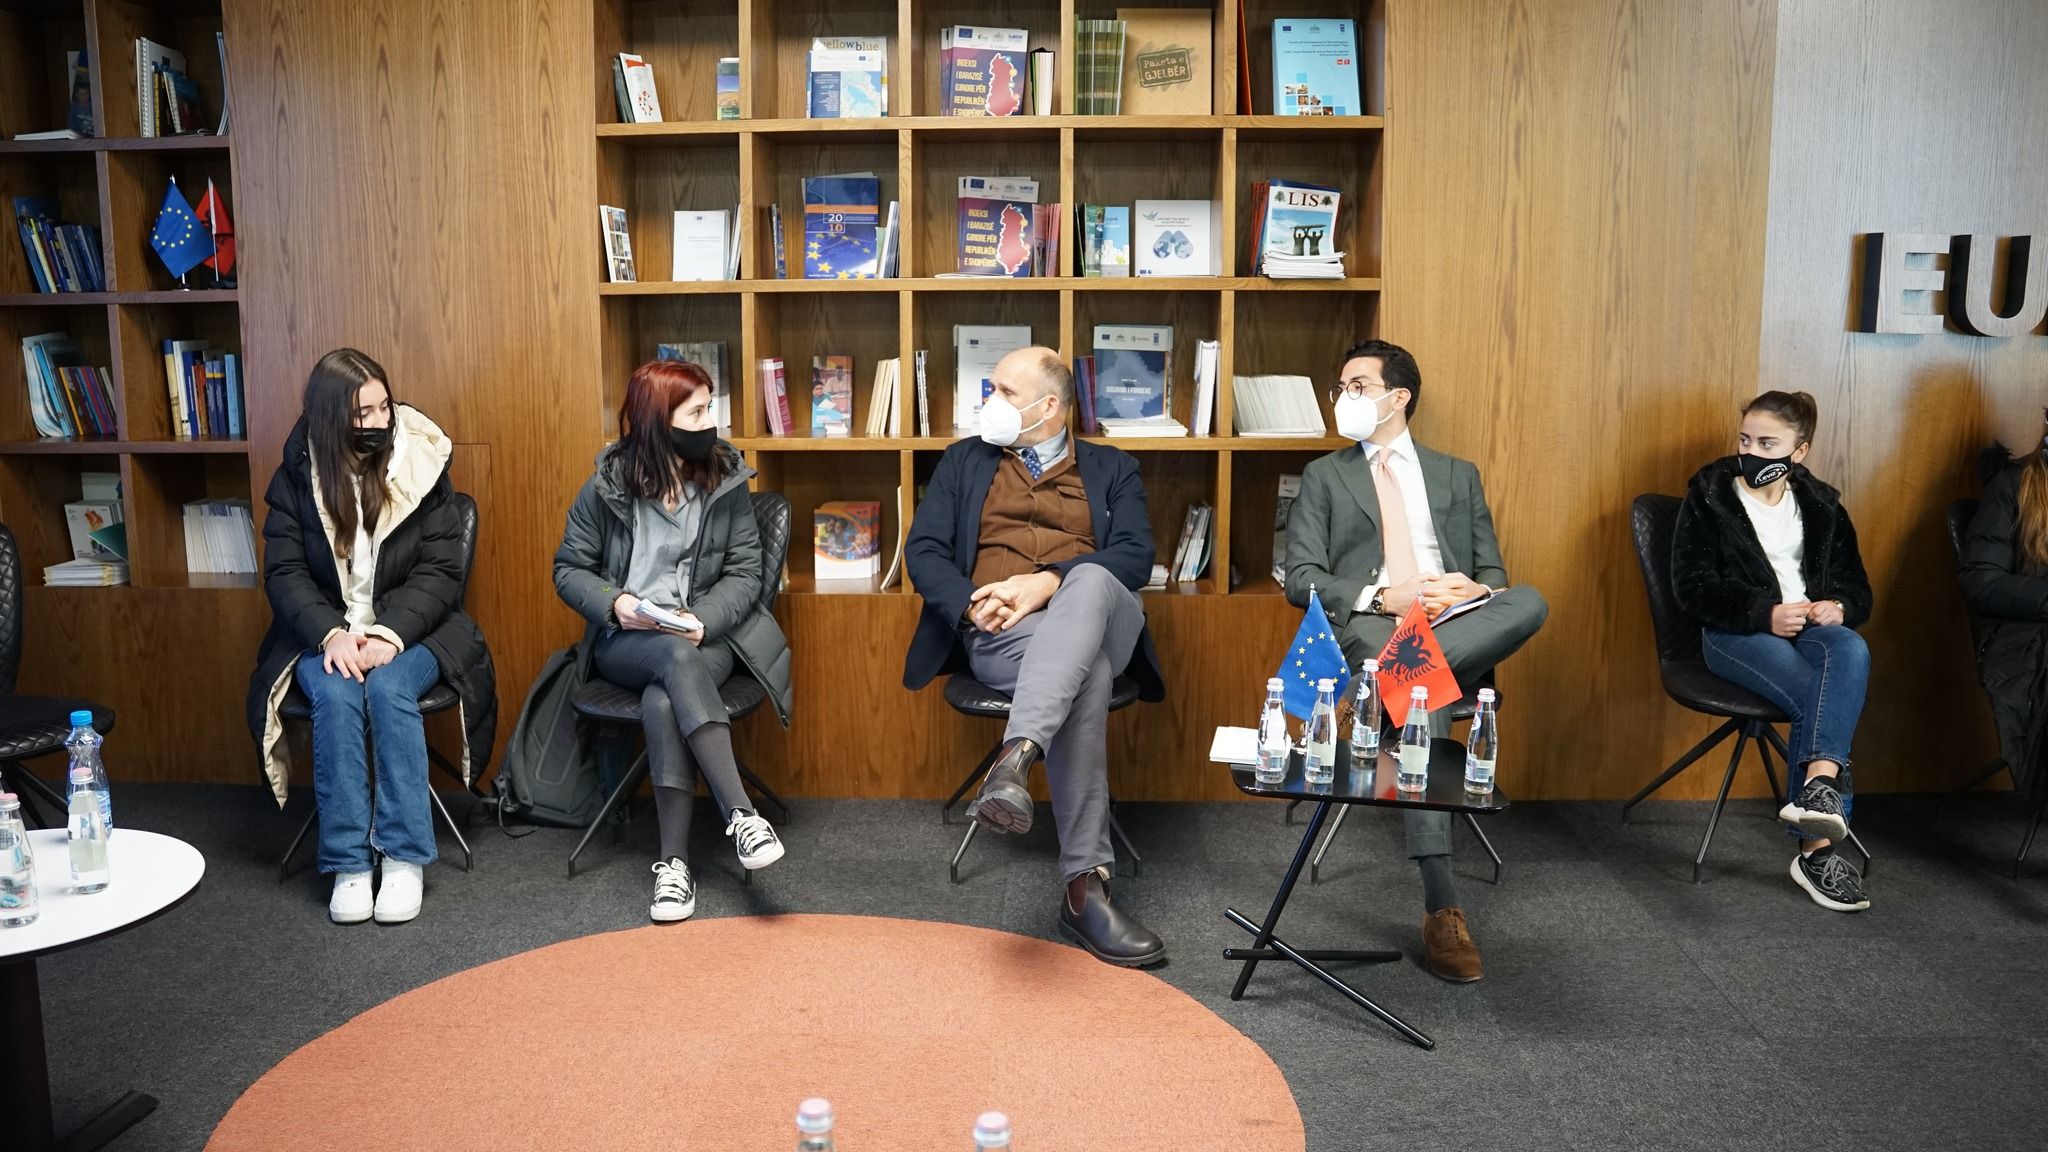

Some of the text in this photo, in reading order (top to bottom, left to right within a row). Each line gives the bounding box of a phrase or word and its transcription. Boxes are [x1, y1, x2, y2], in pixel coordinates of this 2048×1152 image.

[1143, 57, 1177, 69] Paketa
[1144, 65, 1187, 81] GJELBËR
[1288, 192, 1319, 207] LIS
[827, 213, 843, 222] 20
[828, 223, 843, 232] 10
